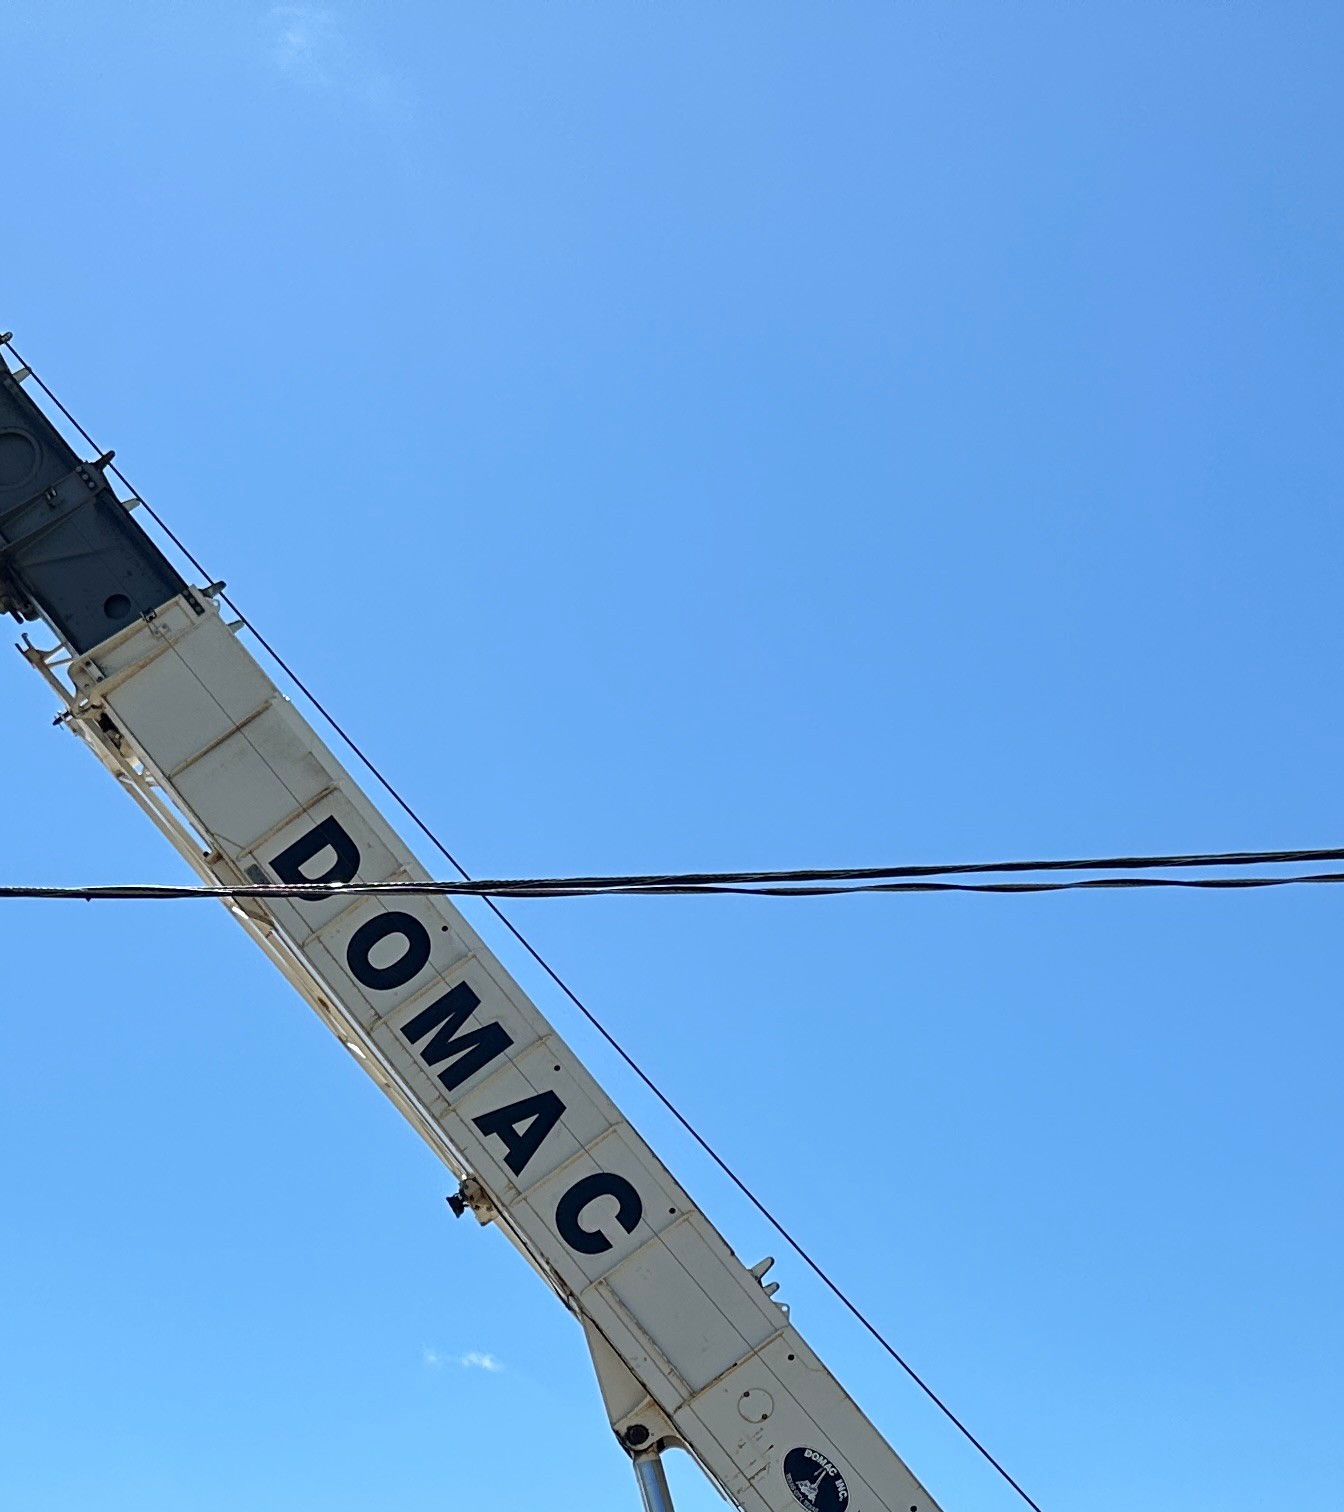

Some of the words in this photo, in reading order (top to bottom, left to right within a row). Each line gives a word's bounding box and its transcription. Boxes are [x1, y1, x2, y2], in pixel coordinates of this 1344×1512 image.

[268, 815, 642, 1254] DOMAC
[804, 1448, 838, 1476] DOMAC
[835, 1478, 848, 1502] INC.
